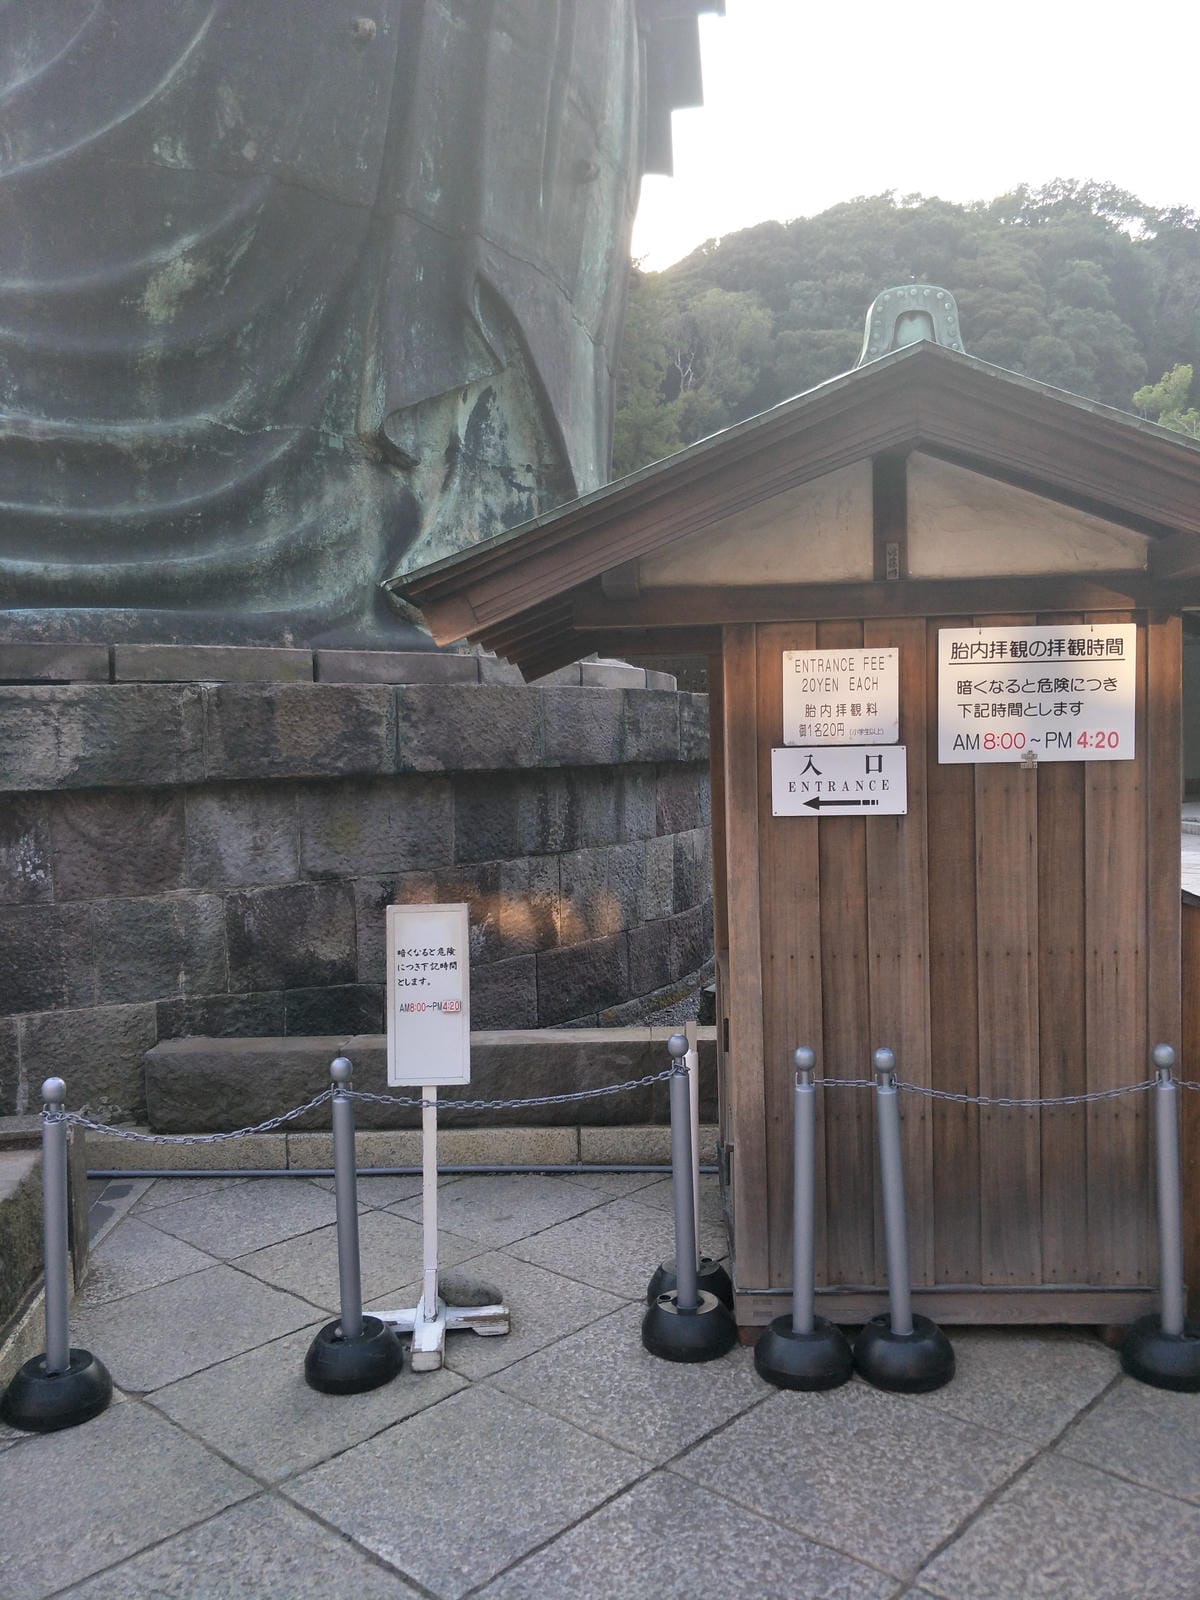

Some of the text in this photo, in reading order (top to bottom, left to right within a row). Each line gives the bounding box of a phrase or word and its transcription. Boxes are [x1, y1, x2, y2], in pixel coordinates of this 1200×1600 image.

[951, 638, 1124, 661] 胎内拝観の拝観時間
[795, 656, 885, 673] ENTRANCE FEE
[802, 676, 879, 692] 20YEN EACH
[957, 677, 1118, 695] 暗くなると危険につき
[957, 701, 1084, 719] 下記時間とします
[788, 779, 890, 793] ENTRANCE
[397, 947, 456, 958] 暗くなると危険
[397, 961, 458, 971] につき下記時間
